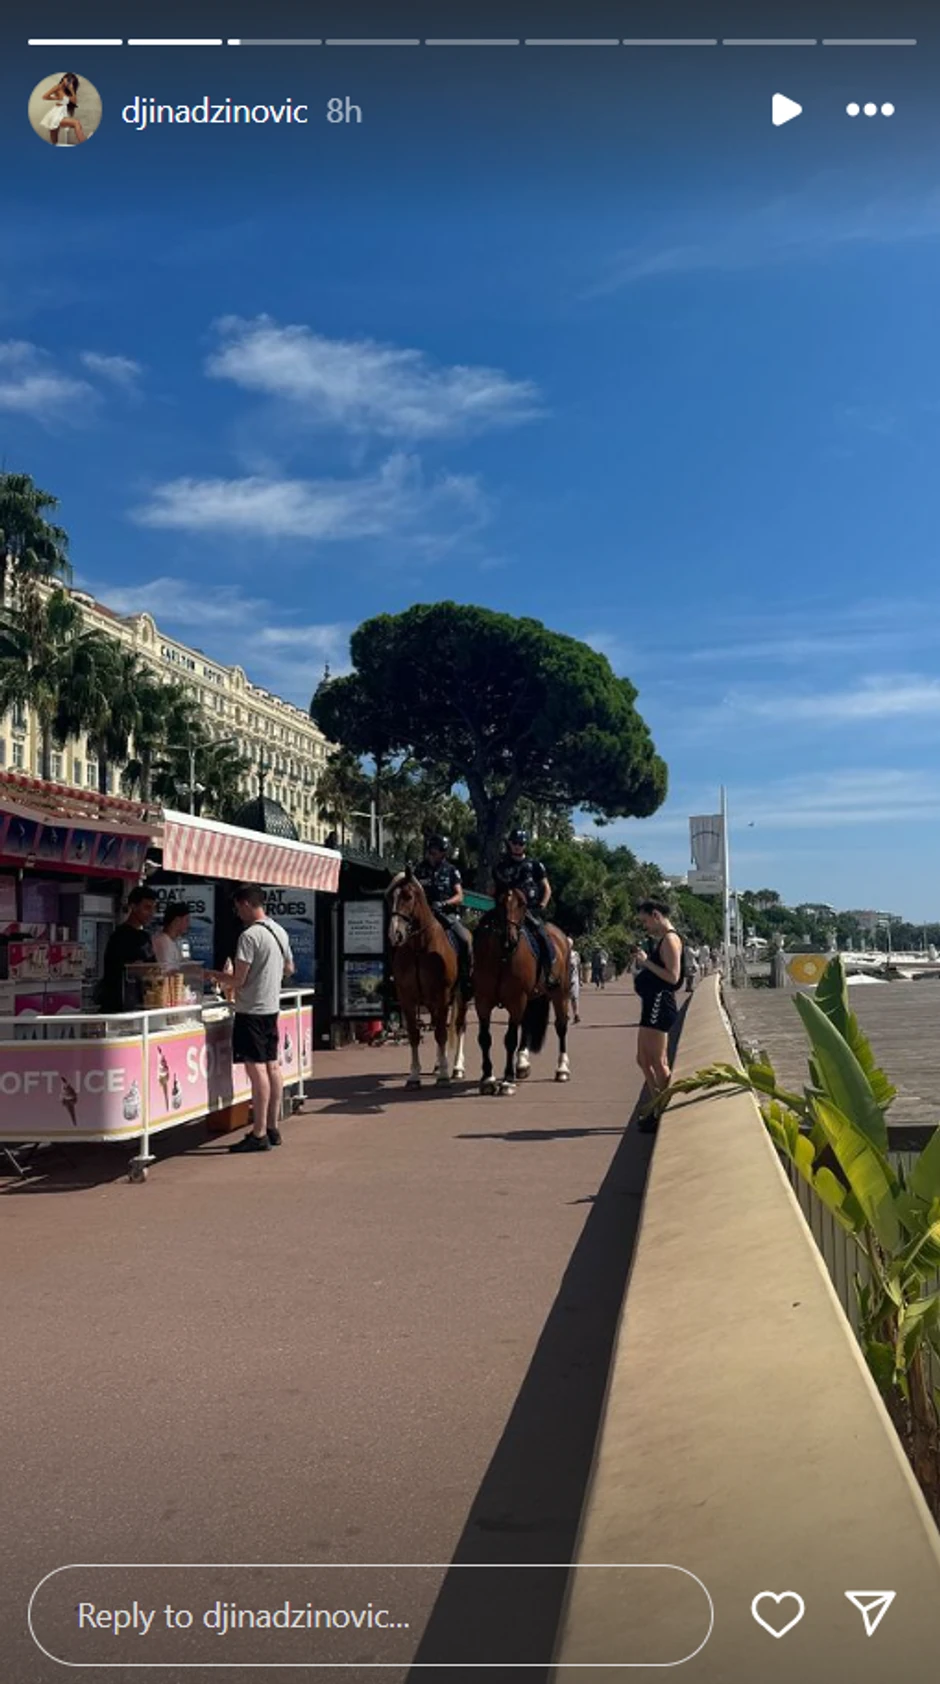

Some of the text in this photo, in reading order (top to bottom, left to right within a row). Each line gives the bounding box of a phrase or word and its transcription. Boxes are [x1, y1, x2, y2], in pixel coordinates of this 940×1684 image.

[156, 888, 186, 901] OAT
[186, 1040, 231, 1084] SOF
[0, 1067, 126, 1095] OFT ICE
